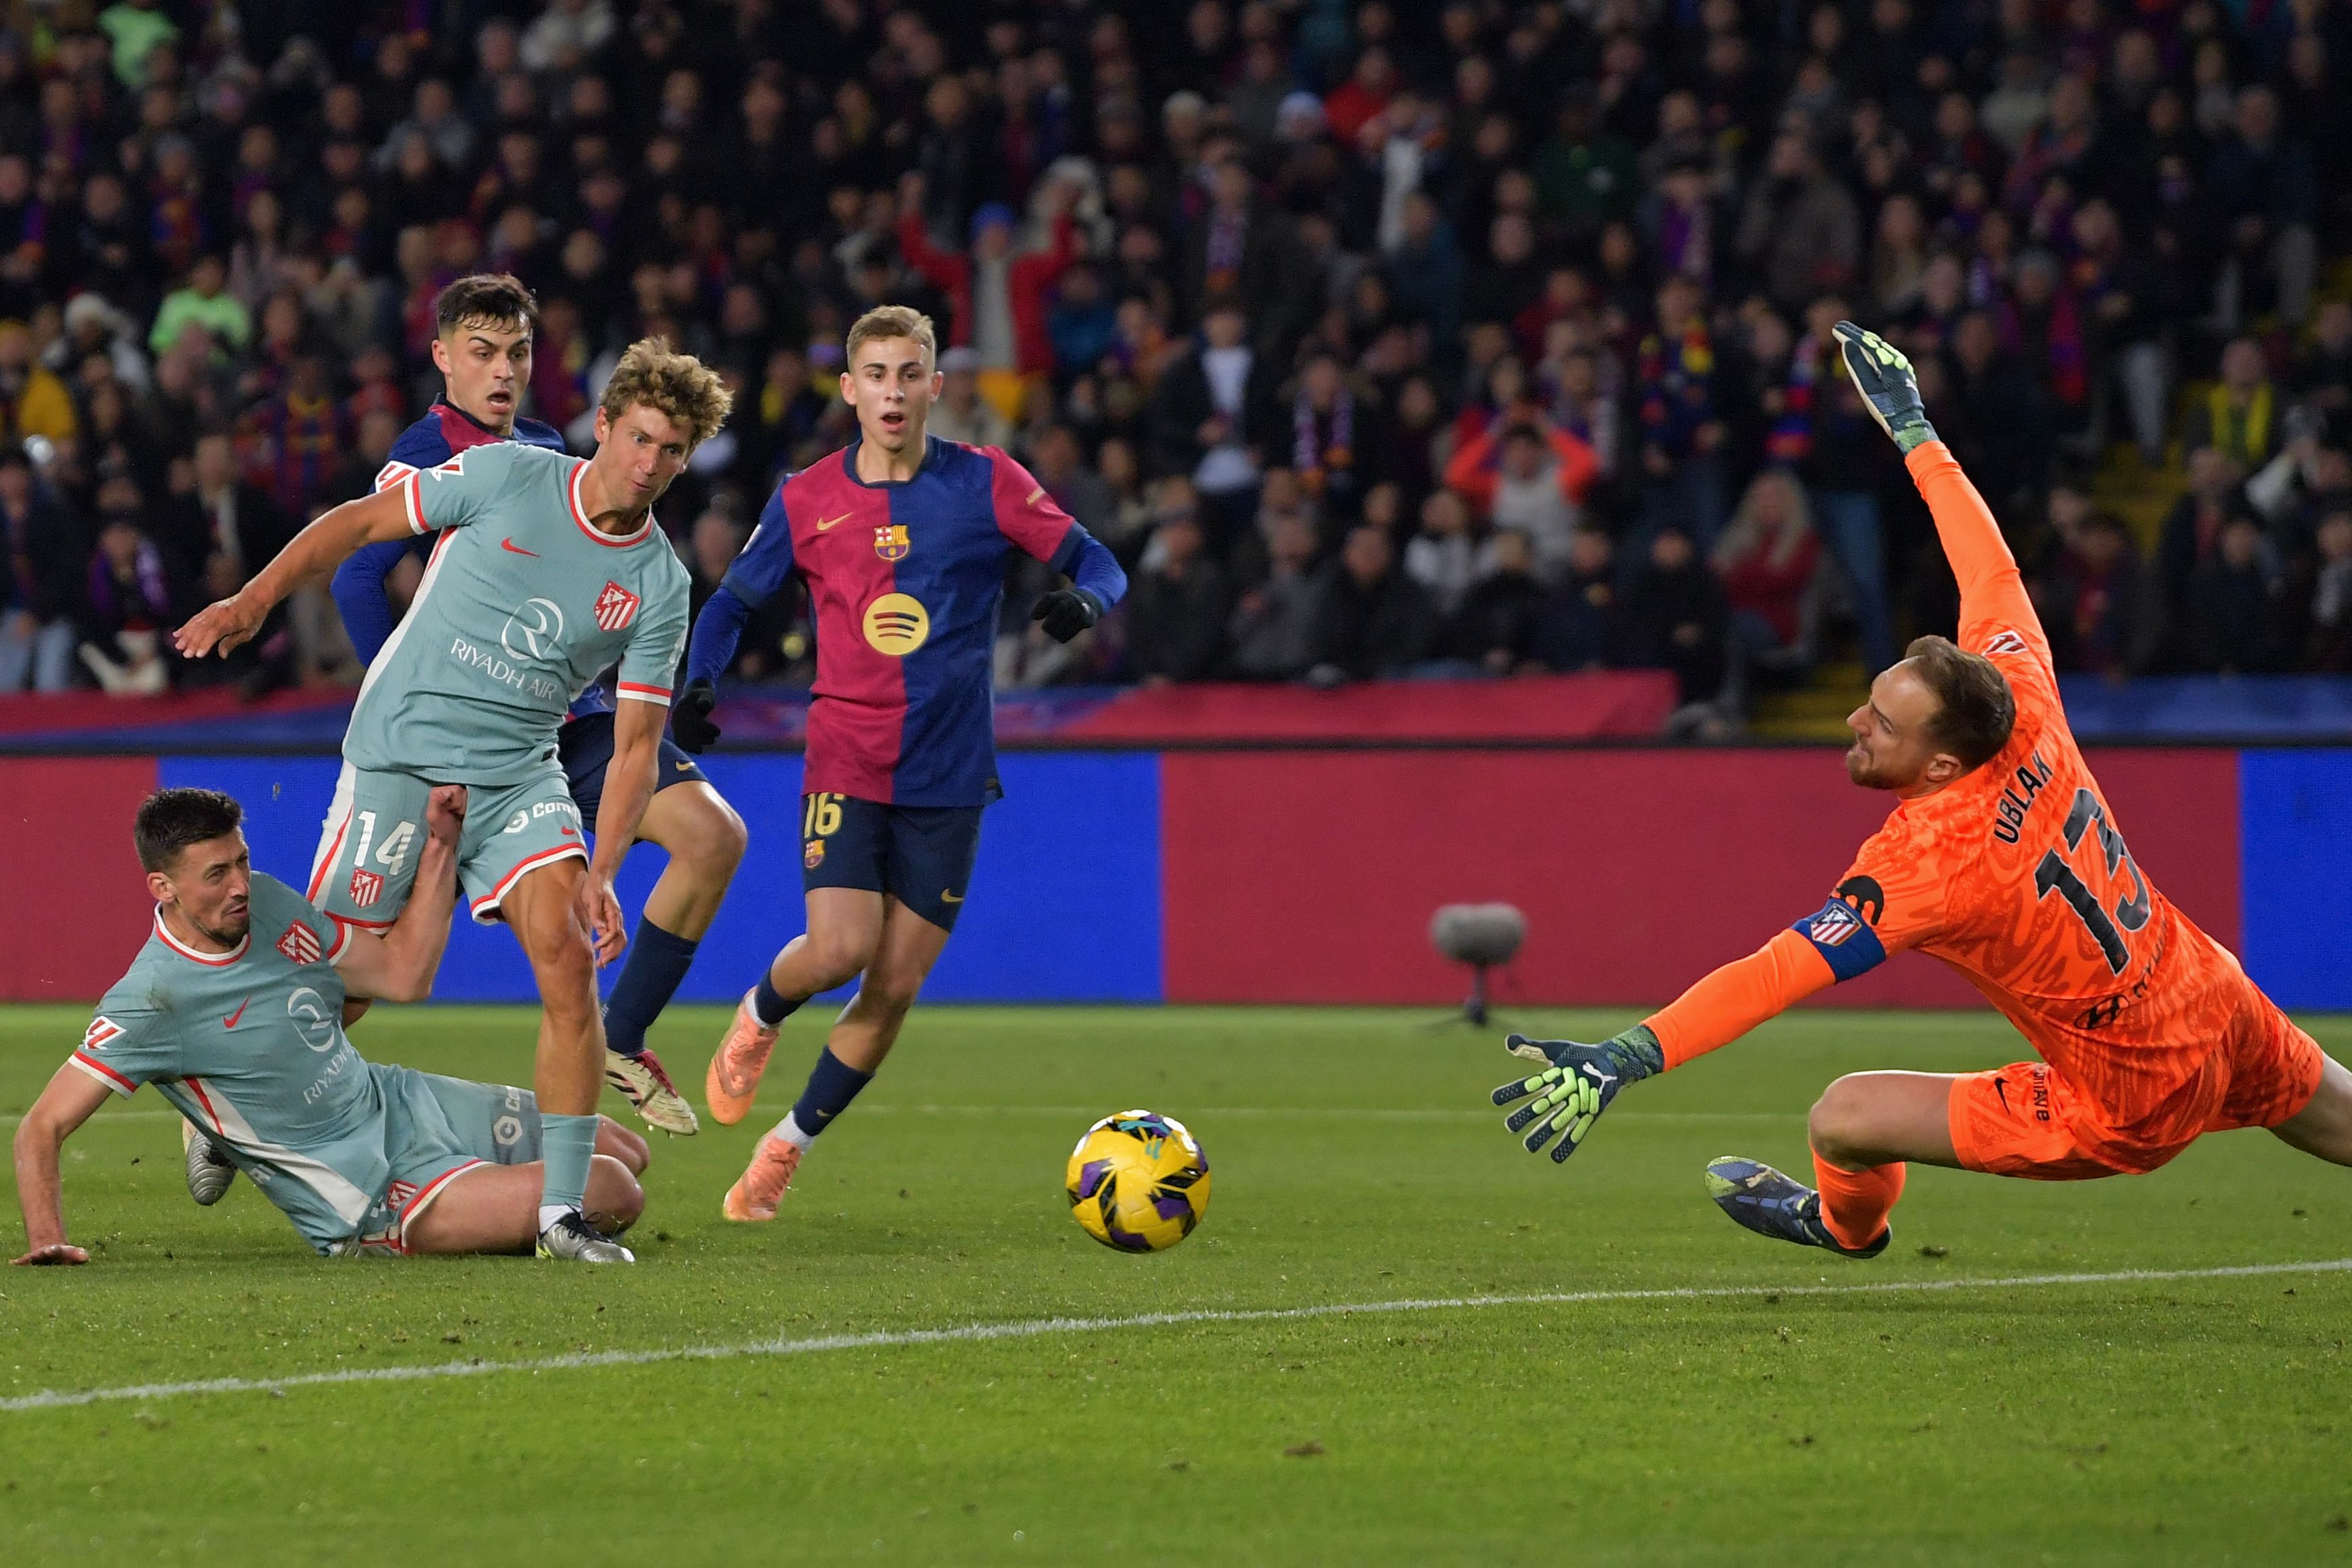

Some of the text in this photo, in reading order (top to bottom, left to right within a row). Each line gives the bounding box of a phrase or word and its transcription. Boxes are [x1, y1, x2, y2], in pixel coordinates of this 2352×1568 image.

[450, 637, 558, 700] RIYADH AIR
[353, 807, 416, 876] 14
[804, 792, 843, 839] 16
[2034, 786, 2152, 978] 13
